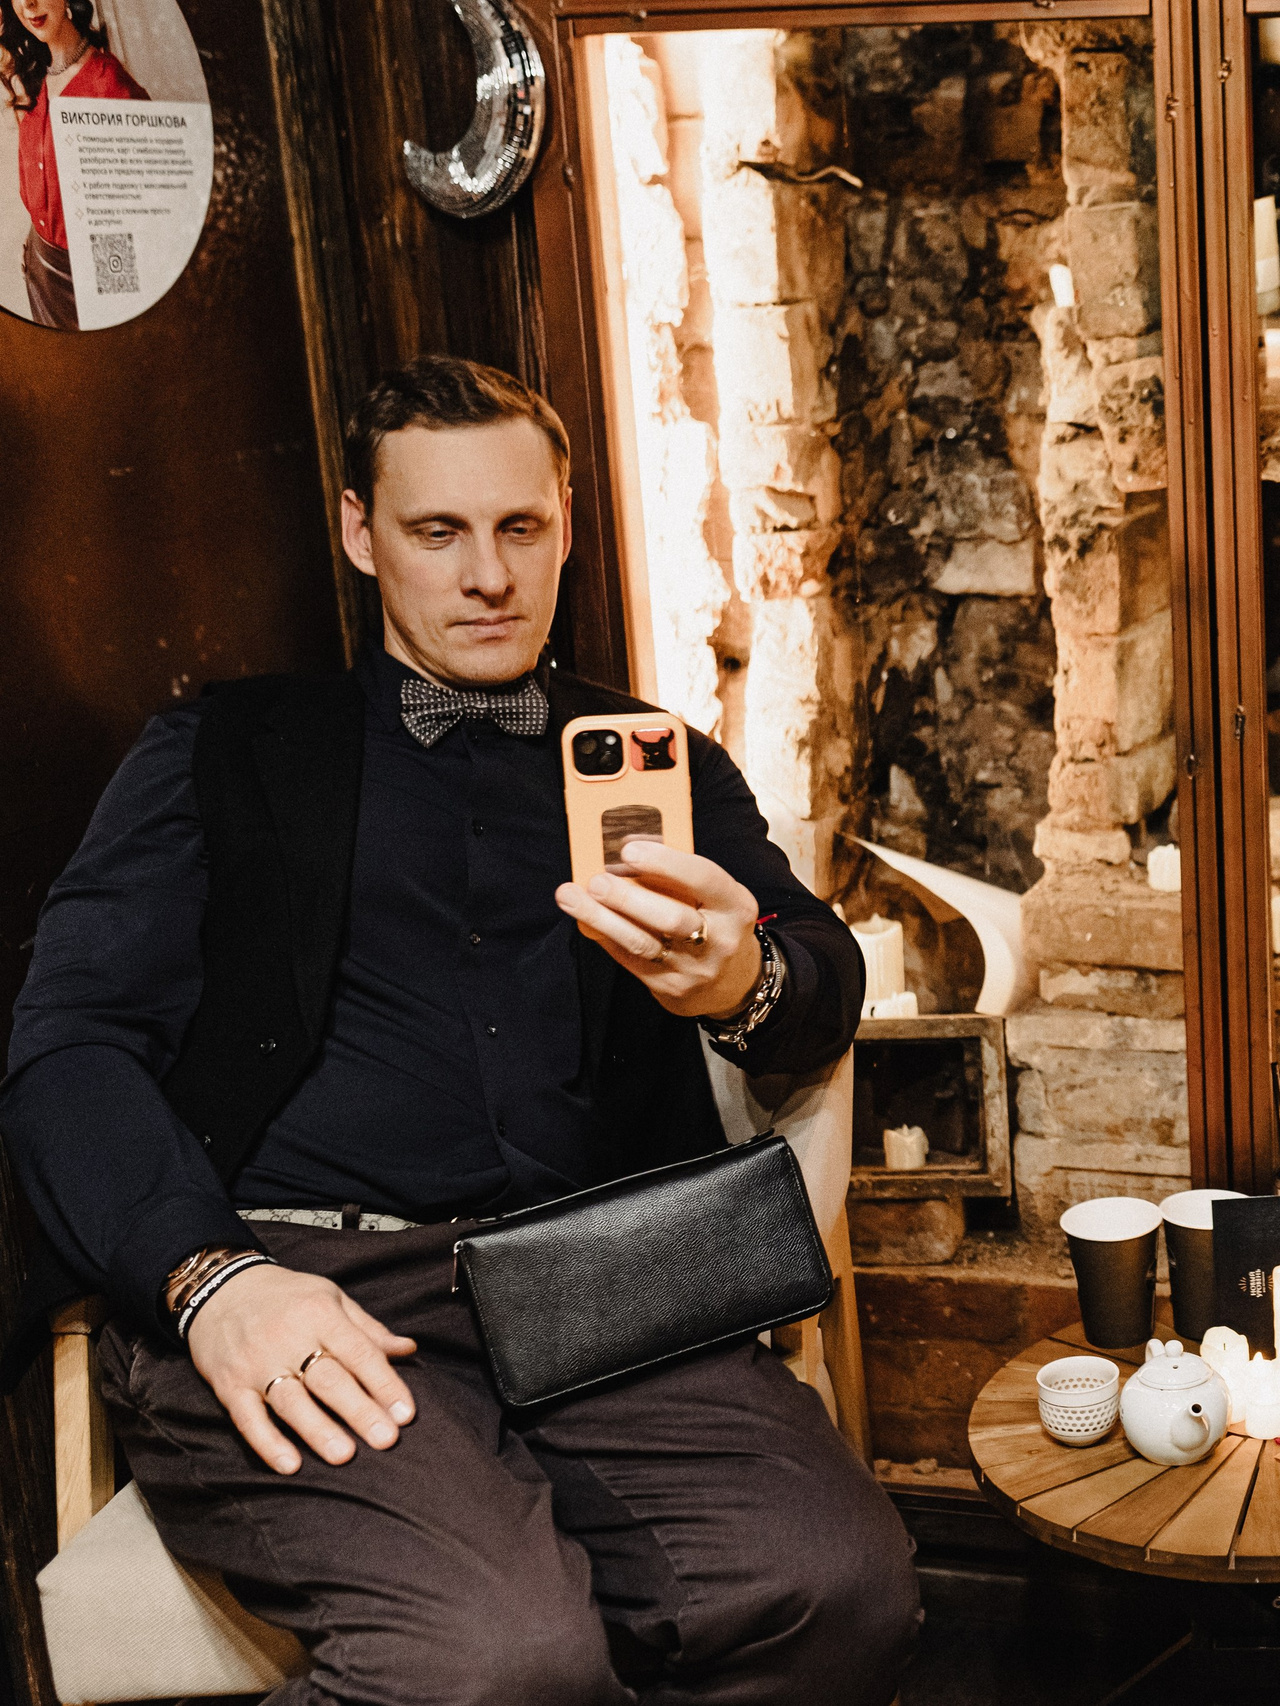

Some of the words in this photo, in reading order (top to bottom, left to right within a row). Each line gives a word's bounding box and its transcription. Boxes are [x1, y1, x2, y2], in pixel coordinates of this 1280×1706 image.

[61, 111, 123, 126] ВИКТОРИЯ
[126, 114, 187, 128] ГОРШКОВА
[83, 136, 114, 144] помощью
[89, 182, 110, 190] работе
[1248, 1271, 1257, 1296] НОВЫЙ
[1255, 1268, 1264, 1298] УРОВЕНЬ
